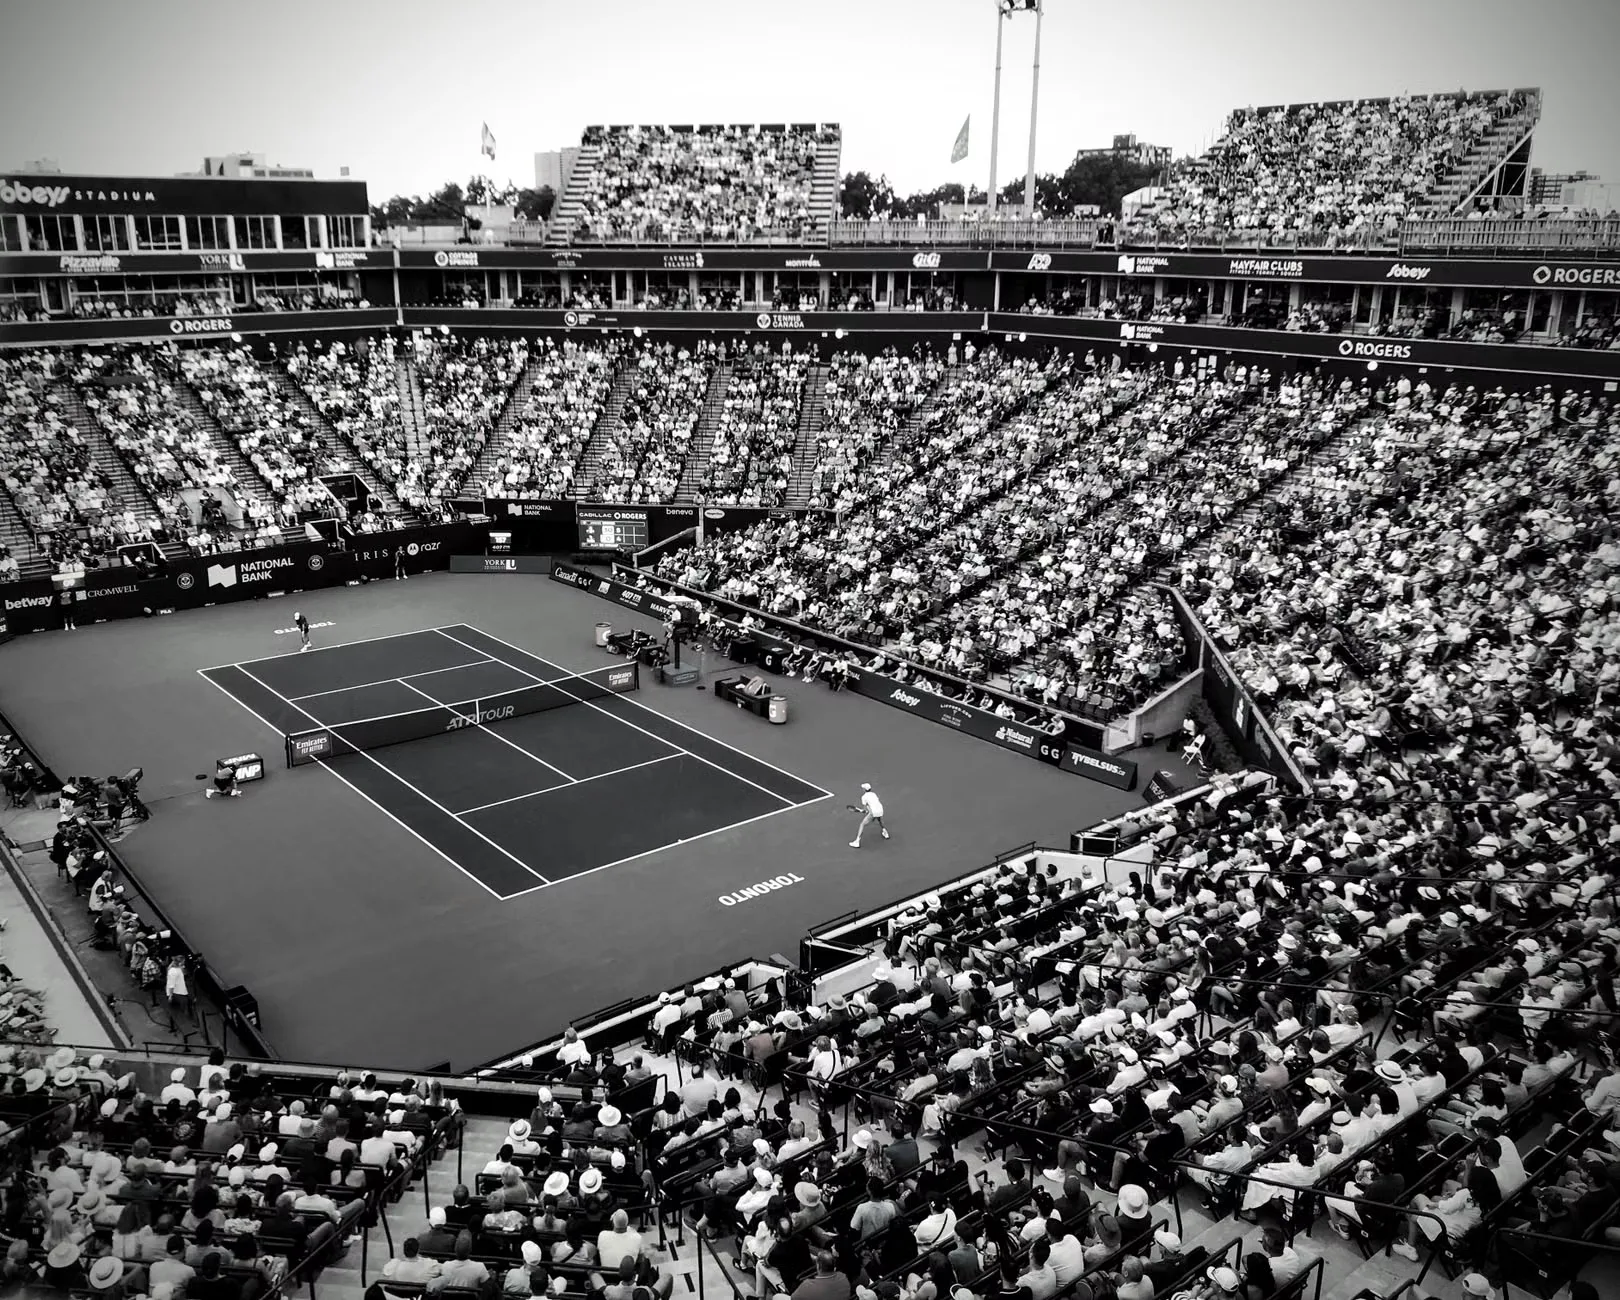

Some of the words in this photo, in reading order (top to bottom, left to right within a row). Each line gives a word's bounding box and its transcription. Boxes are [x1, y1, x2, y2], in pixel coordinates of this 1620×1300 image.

[0, 179, 70, 207] obeys
[75, 190, 155, 201] STADIUM
[60, 255, 120, 268] Pizzaville
[199, 254, 228, 264] YORK
[1136, 256, 1168, 266] NATIONAL
[1230, 260, 1270, 270] MAYFAIR
[1270, 260, 1303, 272] CLUBS
[1136, 264, 1154, 273] BANK
[1386, 264, 1430, 280] Sobeys
[184, 318, 232, 332] ROGERS
[1136, 325, 1164, 334] NATIONAL
[1354, 342, 1412, 358] ROGERS
[666, 508, 694, 516] beneva
[420, 542, 441, 552] razr
[354, 548, 388, 561] IRIS
[240, 556, 294, 572] NATIONAL
[241, 570, 272, 583] BANK
[554, 566, 578, 582] Canada
[87, 584, 139, 598] CROMWELL
[5, 596, 54, 610] betway
[766, 655, 772, 666] G
[608, 672, 632, 680] Emirates
[890, 688, 920, 706] Sobeys
[480, 706, 514, 722] TOUR
[296, 736, 328, 750] Emirates
[1006, 728, 1034, 744] Natural
[1040, 745, 1048, 756] G
[1051, 748, 1060, 759] G
[718, 872, 804, 906] TORONTO
